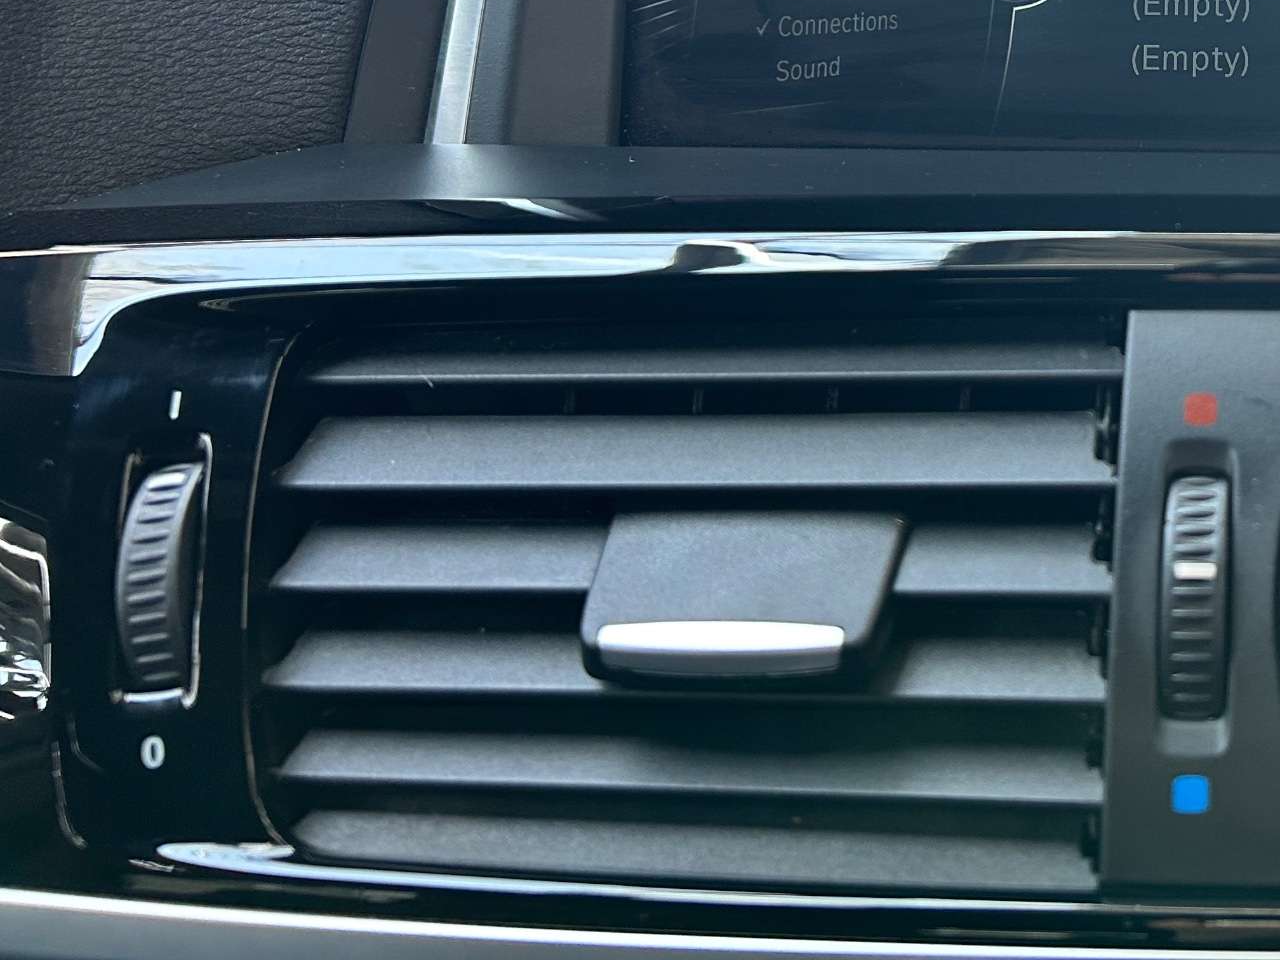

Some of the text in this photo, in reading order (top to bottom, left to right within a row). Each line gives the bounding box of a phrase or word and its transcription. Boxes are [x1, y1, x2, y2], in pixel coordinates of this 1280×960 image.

[778, 12, 898, 37] Connections
[776, 56, 841, 82] Sound
[1131, 44, 1249, 77] (Empty)
